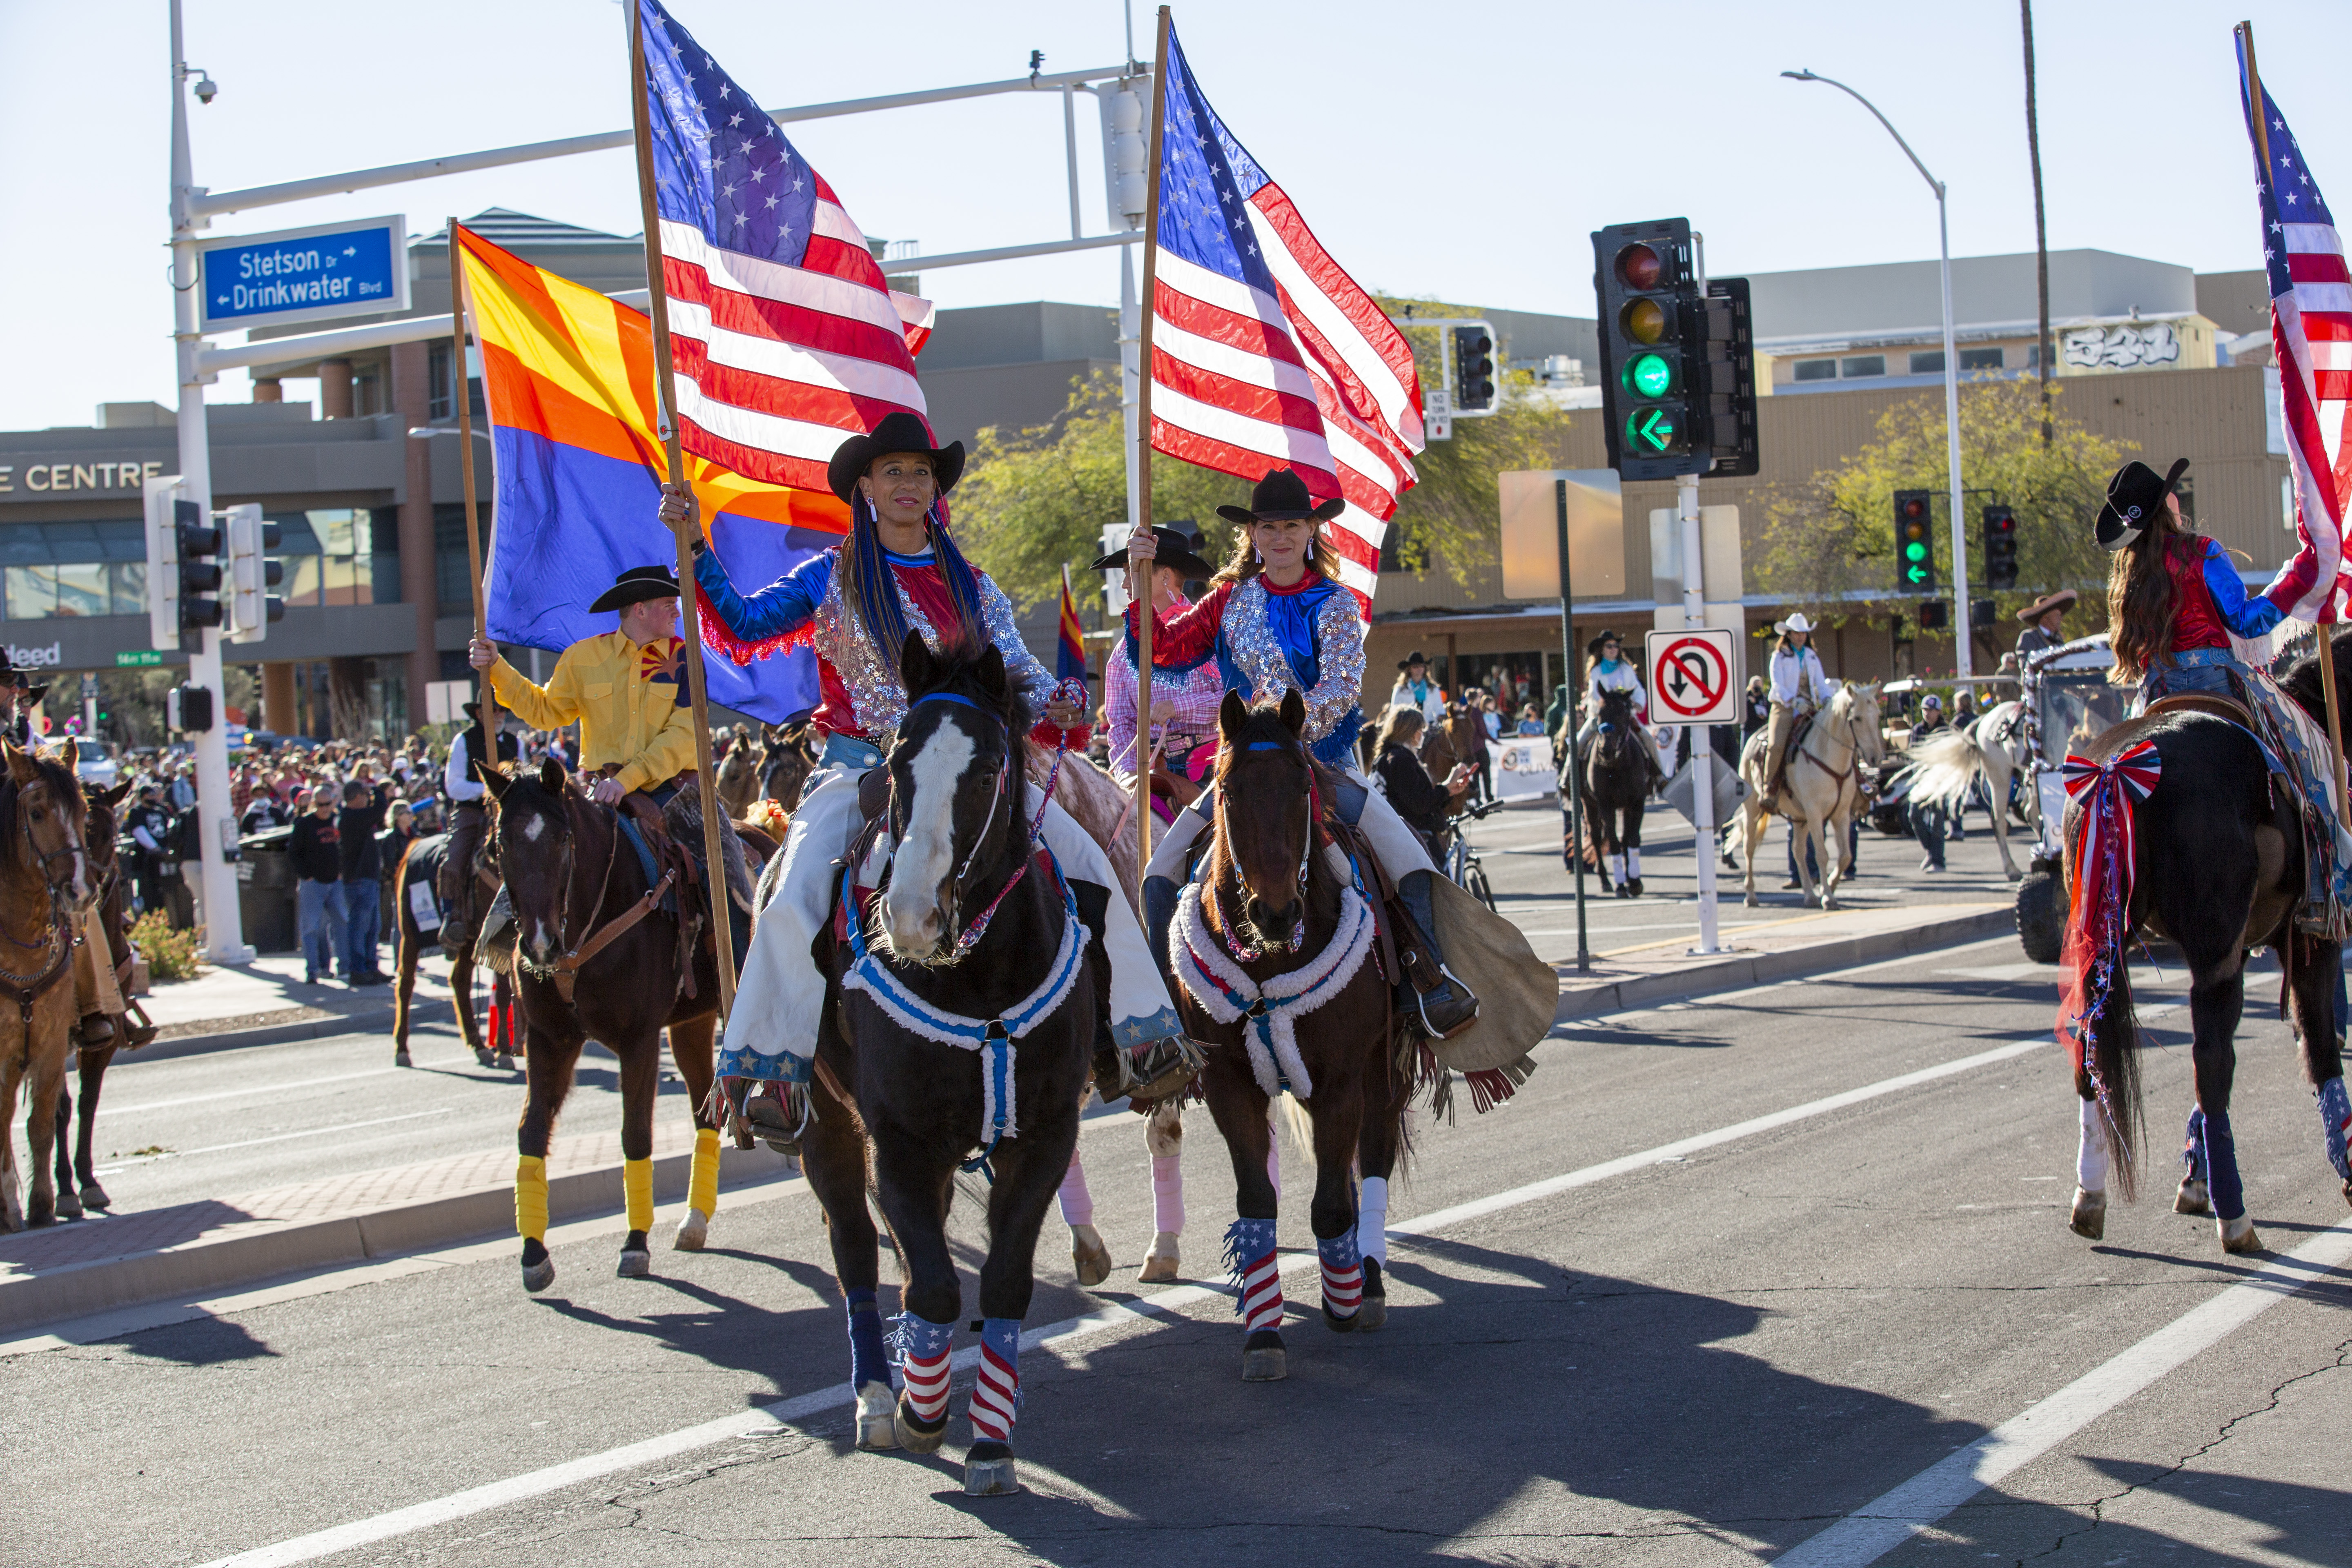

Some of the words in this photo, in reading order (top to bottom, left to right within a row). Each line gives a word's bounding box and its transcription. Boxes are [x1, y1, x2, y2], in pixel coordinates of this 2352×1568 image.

[239, 249, 320, 278] Stetson
[325, 256, 338, 268] Dr
[234, 274, 352, 310] Drinkwater
[359, 281, 382, 295] Blvd
[1432, 394, 1444, 403] NO
